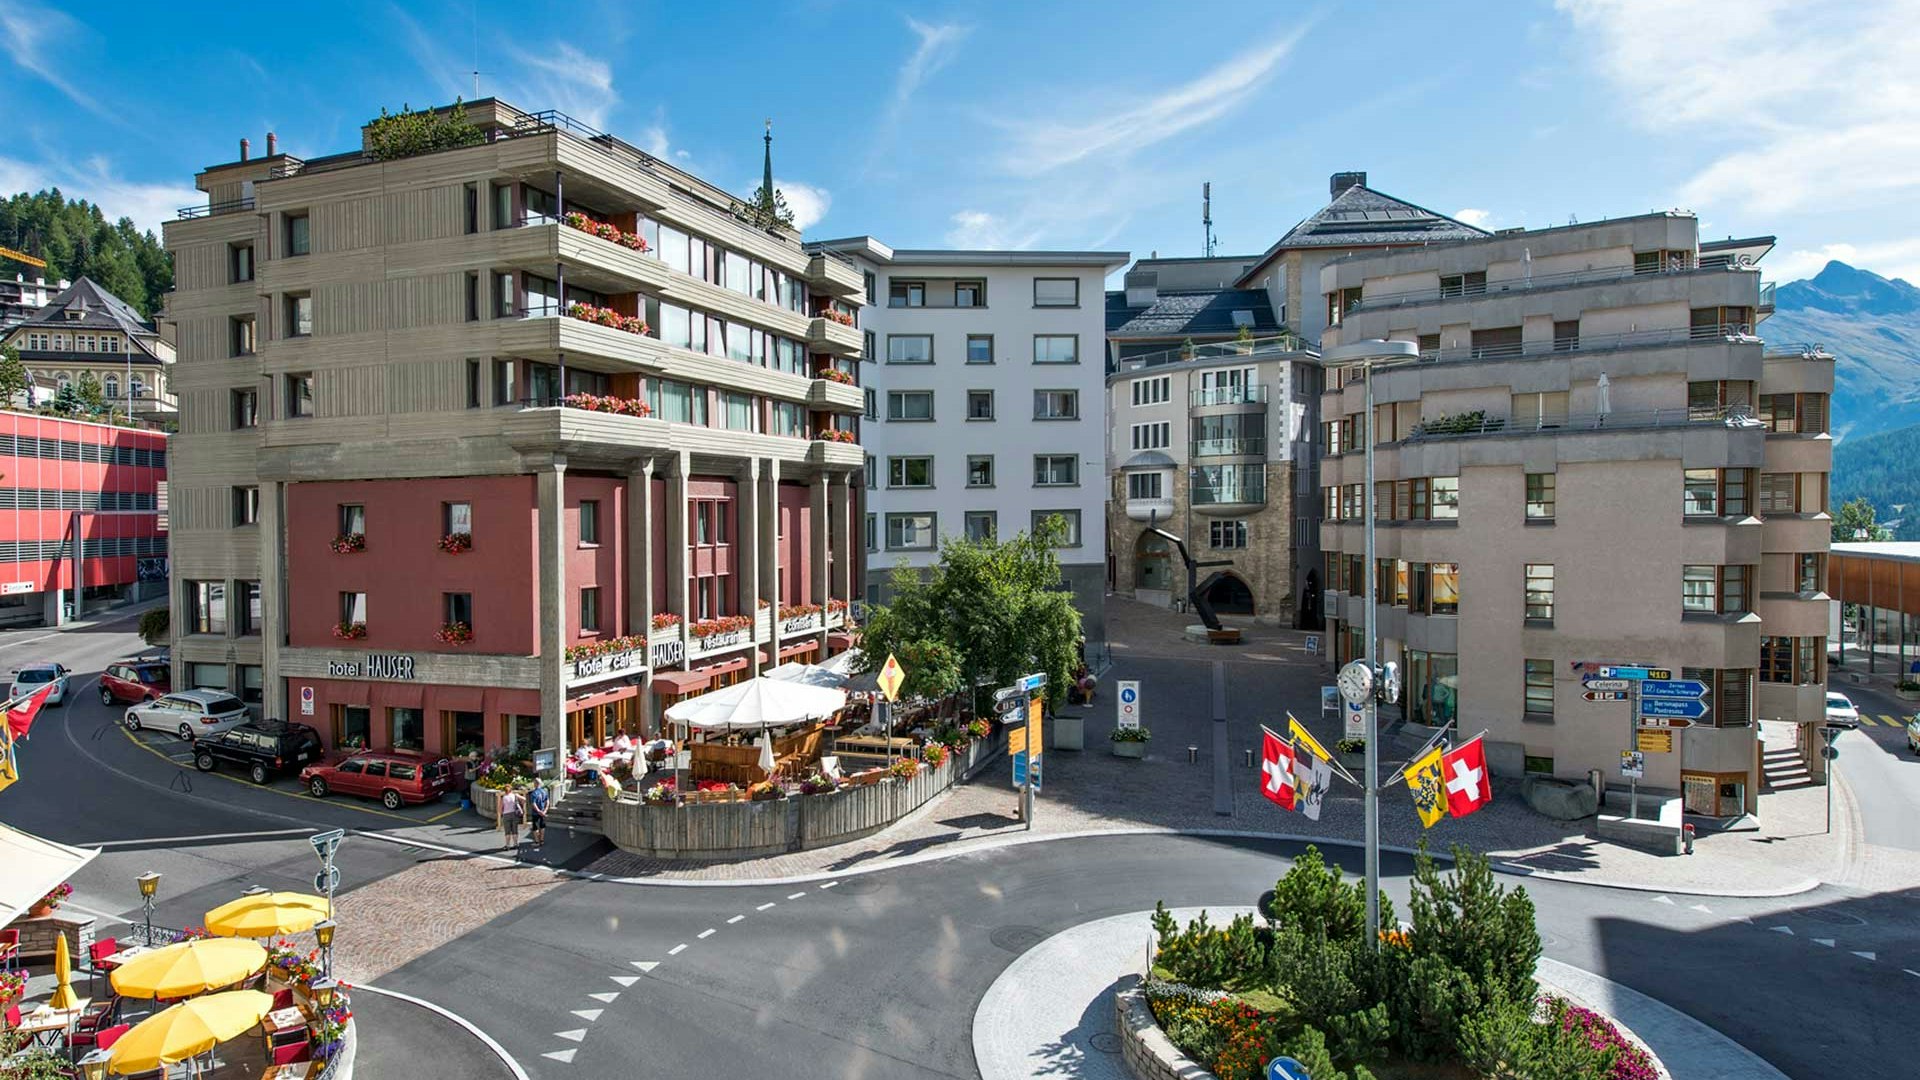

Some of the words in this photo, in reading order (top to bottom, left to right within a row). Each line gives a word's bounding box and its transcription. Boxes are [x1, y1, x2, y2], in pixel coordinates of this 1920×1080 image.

[653, 640, 684, 666] HAUSER
[327, 660, 361, 677] hotel
[366, 654, 415, 680] HAUSER
[578, 659, 604, 676] hotel
